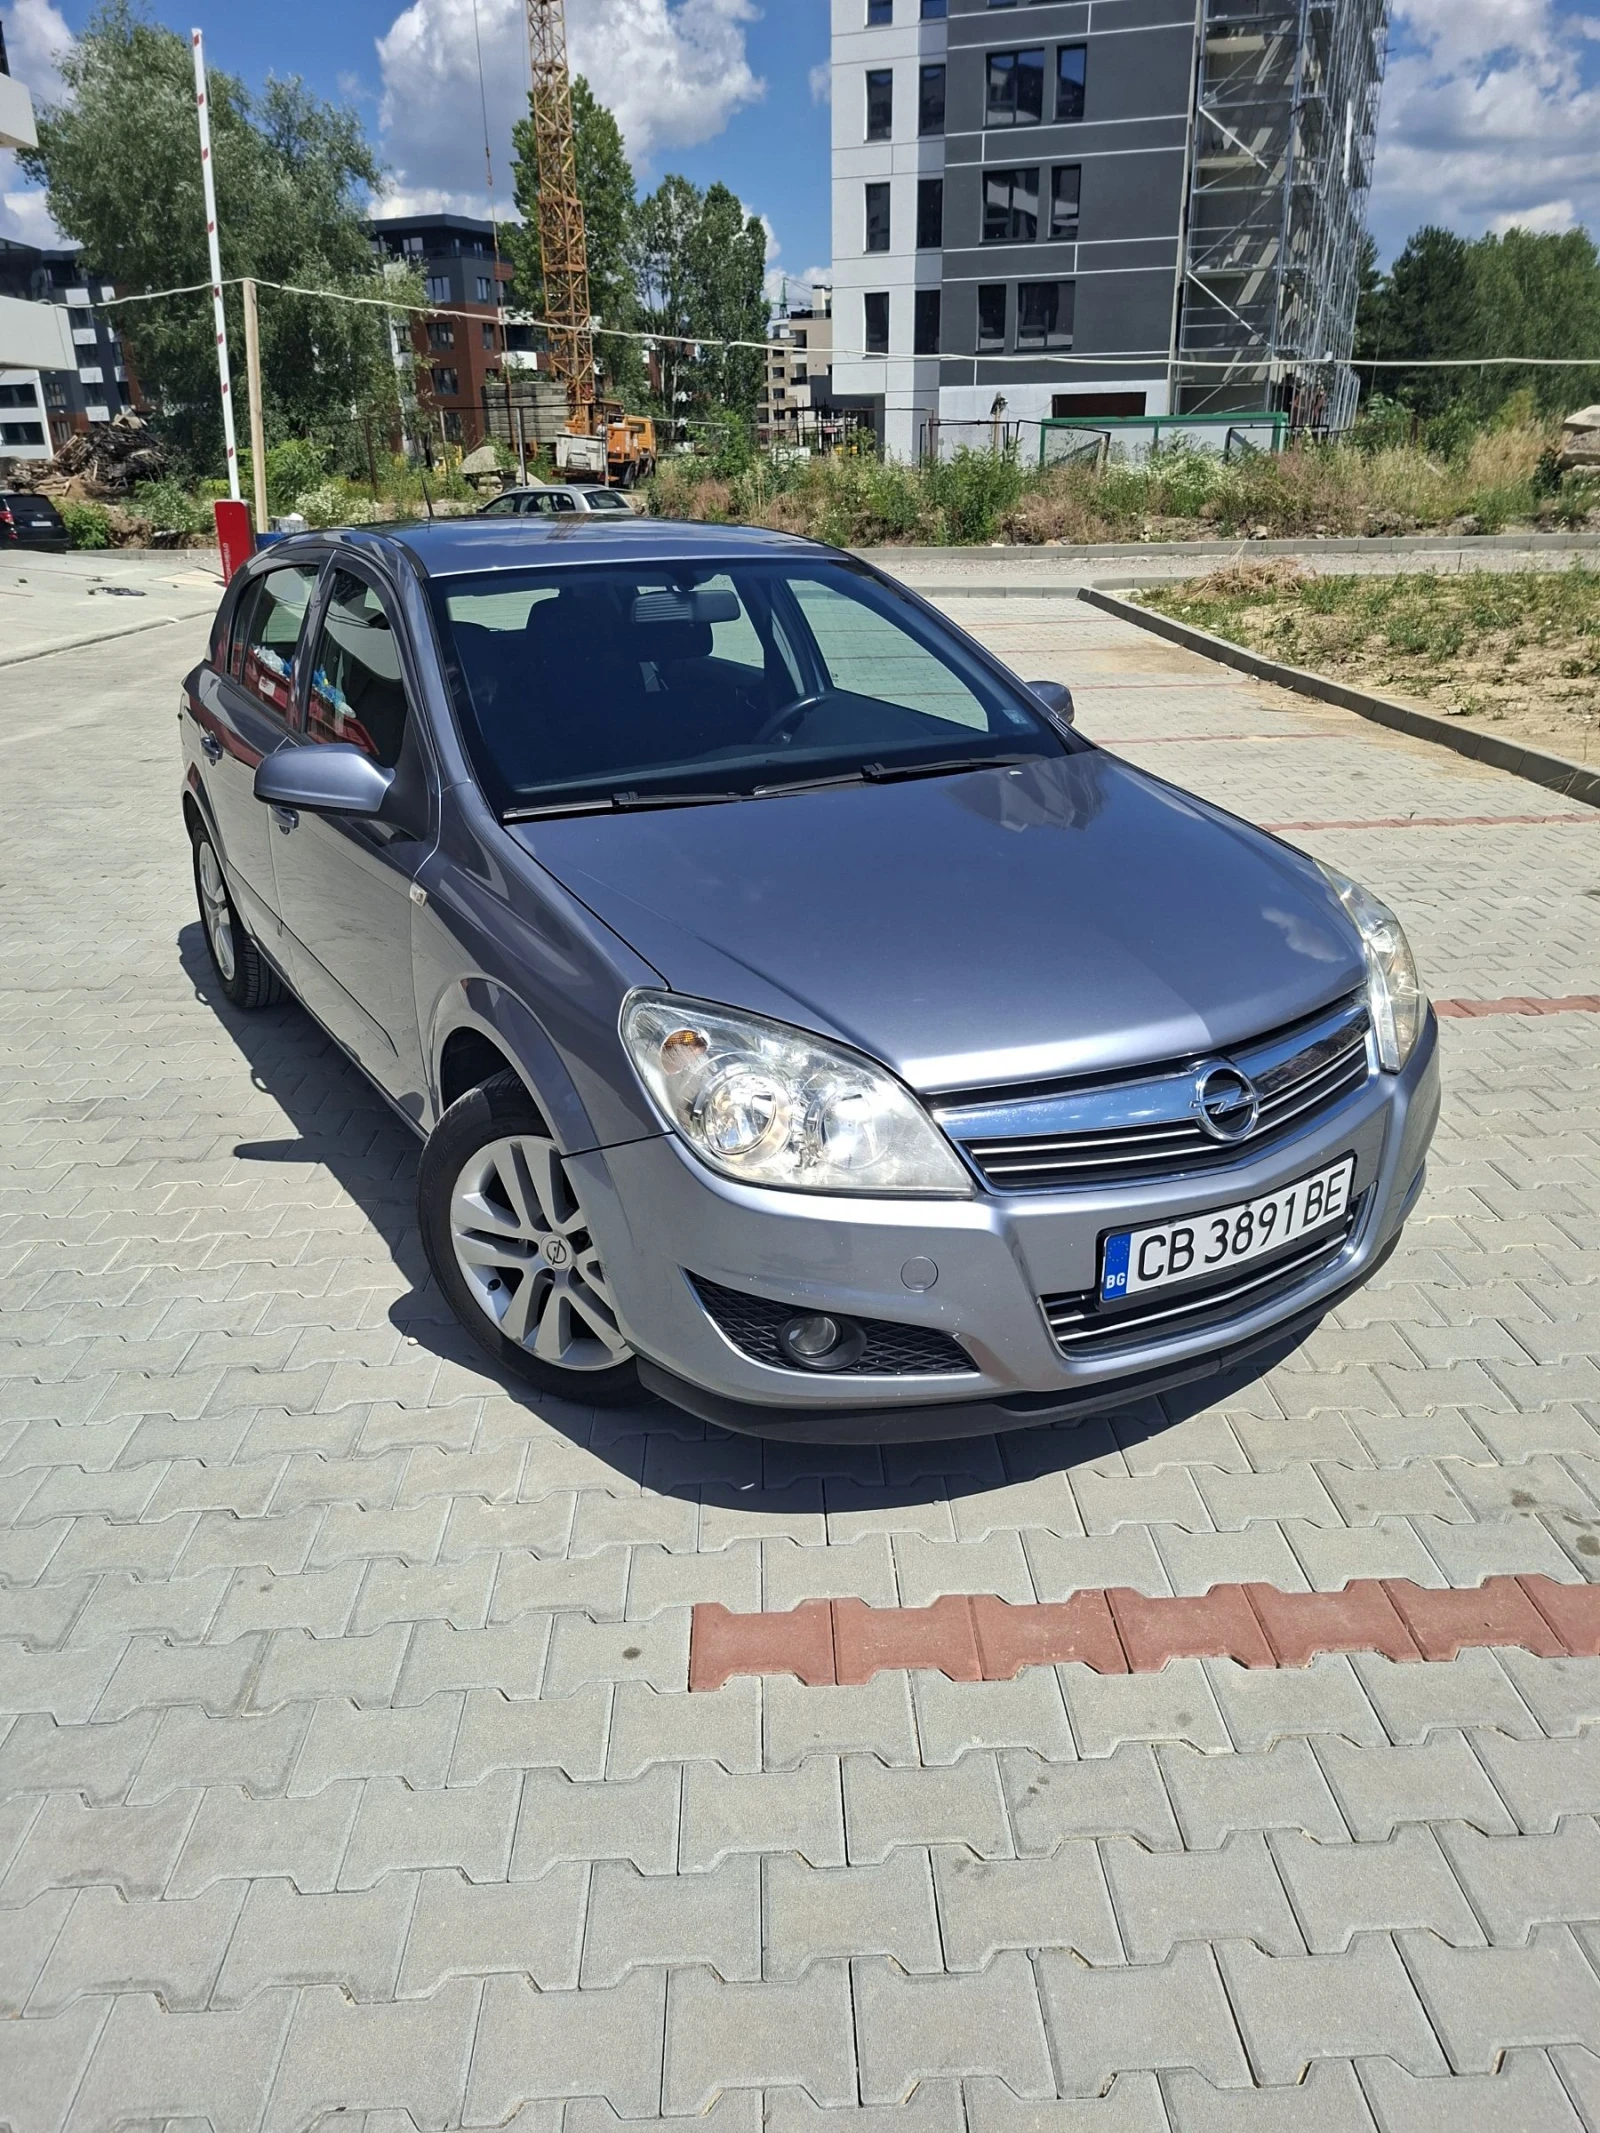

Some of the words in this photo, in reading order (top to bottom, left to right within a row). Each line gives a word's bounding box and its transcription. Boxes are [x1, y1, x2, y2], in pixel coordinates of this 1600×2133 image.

[1138, 1228, 1195, 1282] CB
[1204, 1192, 1297, 1264] 3891
[1302, 1167, 1346, 1228] BE
[1105, 1272, 1126, 1289] BG
